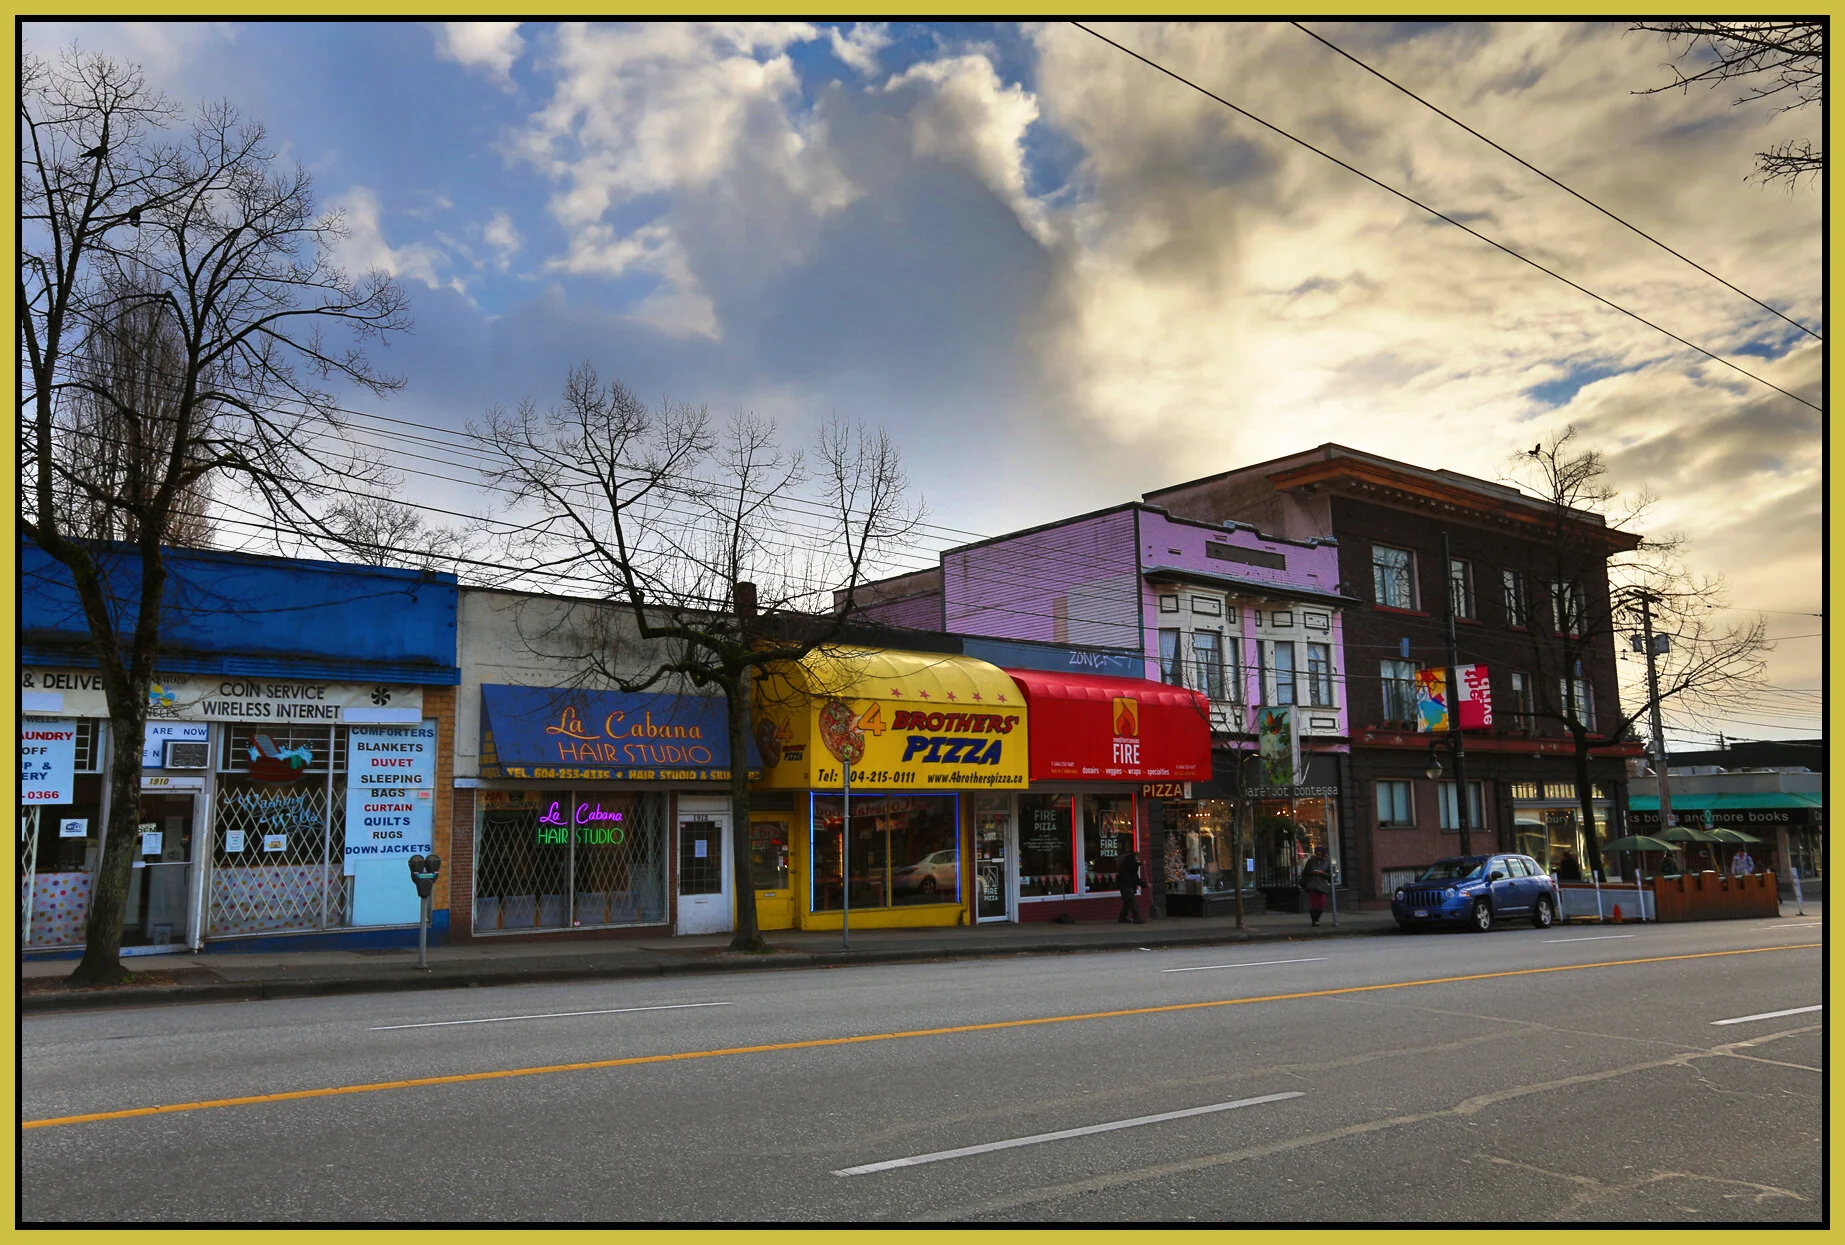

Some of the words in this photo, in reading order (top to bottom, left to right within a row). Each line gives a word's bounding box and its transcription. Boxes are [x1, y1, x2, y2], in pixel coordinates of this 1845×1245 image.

[22, 672, 36, 689] &
[220, 682, 260, 698] COIN
[266, 684, 325, 700] SERVICE
[202, 701, 271, 717] WIRELESS
[276, 703, 341, 719] INTERNET
[546, 706, 600, 740] La
[605, 710, 703, 739] Cabana
[857, 701, 887, 737] 4
[152, 727, 173, 735] ARE
[183, 728, 207, 736] NOW
[351, 726, 434, 738] COMFORTERS
[357, 742, 423, 752] BLANKETS
[558, 742, 619, 762] HAIR
[623, 743, 712, 764] STUDIO
[901, 735, 1003, 765] PIZZA
[1113, 743, 1140, 764] FIRE
[42, 761, 52, 770] &
[371, 758, 413, 767] DUVET
[507, 767, 531, 778] TEL.
[628, 769, 655, 780] HAIR
[659, 769, 697, 780] STUDIO
[700, 770, 708, 780] &
[1082, 766, 1099, 775] donairs
[1105, 767, 1122, 776] veggies
[1128, 768, 1142, 776] wraps
[149, 777, 170, 786] 1910
[360, 774, 423, 784] SLEEPING
[818, 768, 838, 782] Tel:
[849, 770, 916, 784] 04-215-0111
[927, 770, 1023, 787] www.4brotherspizza.ca
[371, 788, 406, 798] BAGS
[1143, 783, 1183, 797] PIZZA
[1293, 784, 1338, 796] contessa
[364, 803, 413, 812] CURTAIN
[539, 801, 568, 826] La
[575, 802, 624, 825] Cabana
[1034, 809, 1057, 821] FIRE
[1644, 811, 1680, 823] bos
[1712, 812, 1744, 822] more
[1748, 811, 1789, 822] books
[363, 816, 411, 827] QUILTS
[1034, 822, 1057, 831] PIZZA
[372, 830, 403, 839] RUGS
[538, 828, 569, 845] HAIR
[575, 828, 624, 845] STUDIO
[345, 845, 378, 855] DOWN
[380, 843, 431, 854] JACKETS
[1100, 839, 1118, 849] FIRE
[1100, 848, 1118, 857] PIZZA
[983, 887, 999, 895] FIRE
